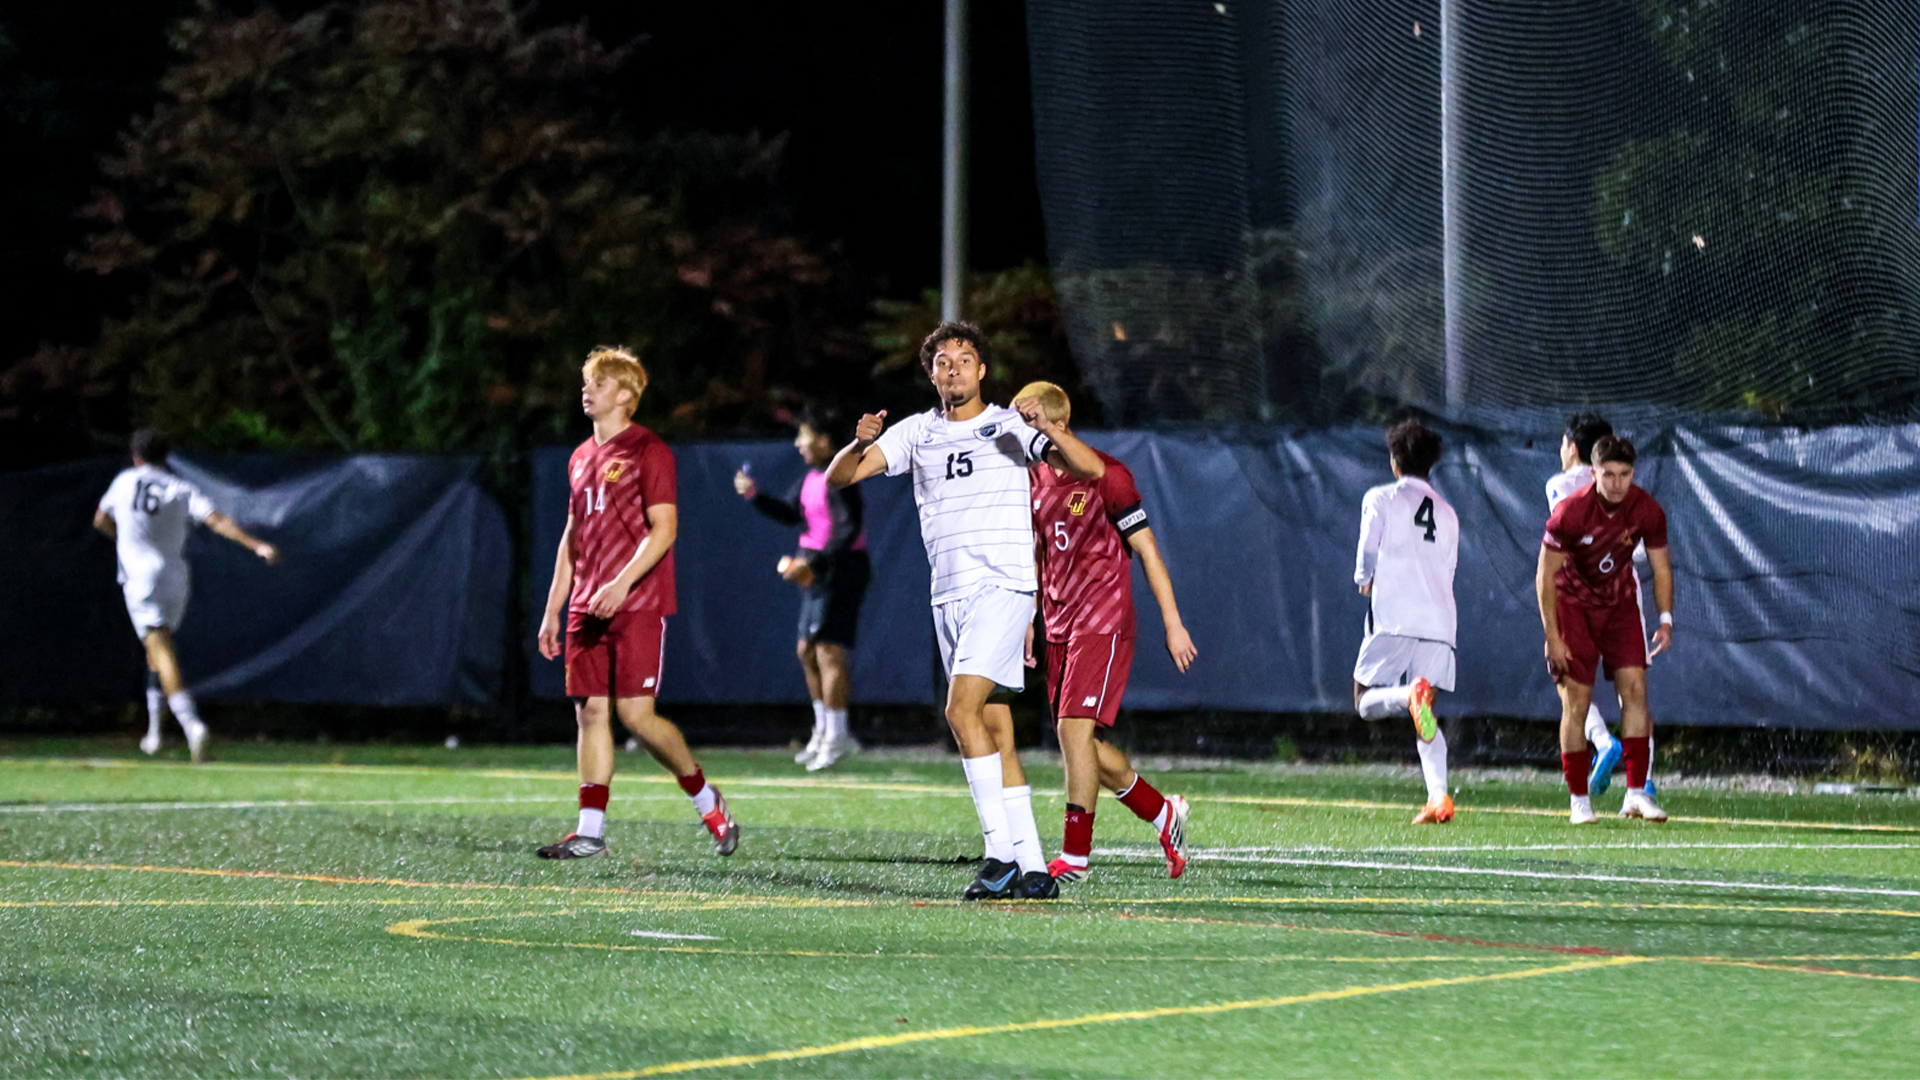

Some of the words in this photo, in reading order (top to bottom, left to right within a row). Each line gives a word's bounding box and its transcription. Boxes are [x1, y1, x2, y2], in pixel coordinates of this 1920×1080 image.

[945, 450, 974, 480] 15
[134, 480, 159, 515] 16
[584, 487, 606, 516] 14
[1414, 495, 1437, 543] 4
[1054, 521, 1069, 551] 5
[1598, 552, 1614, 574] 6
